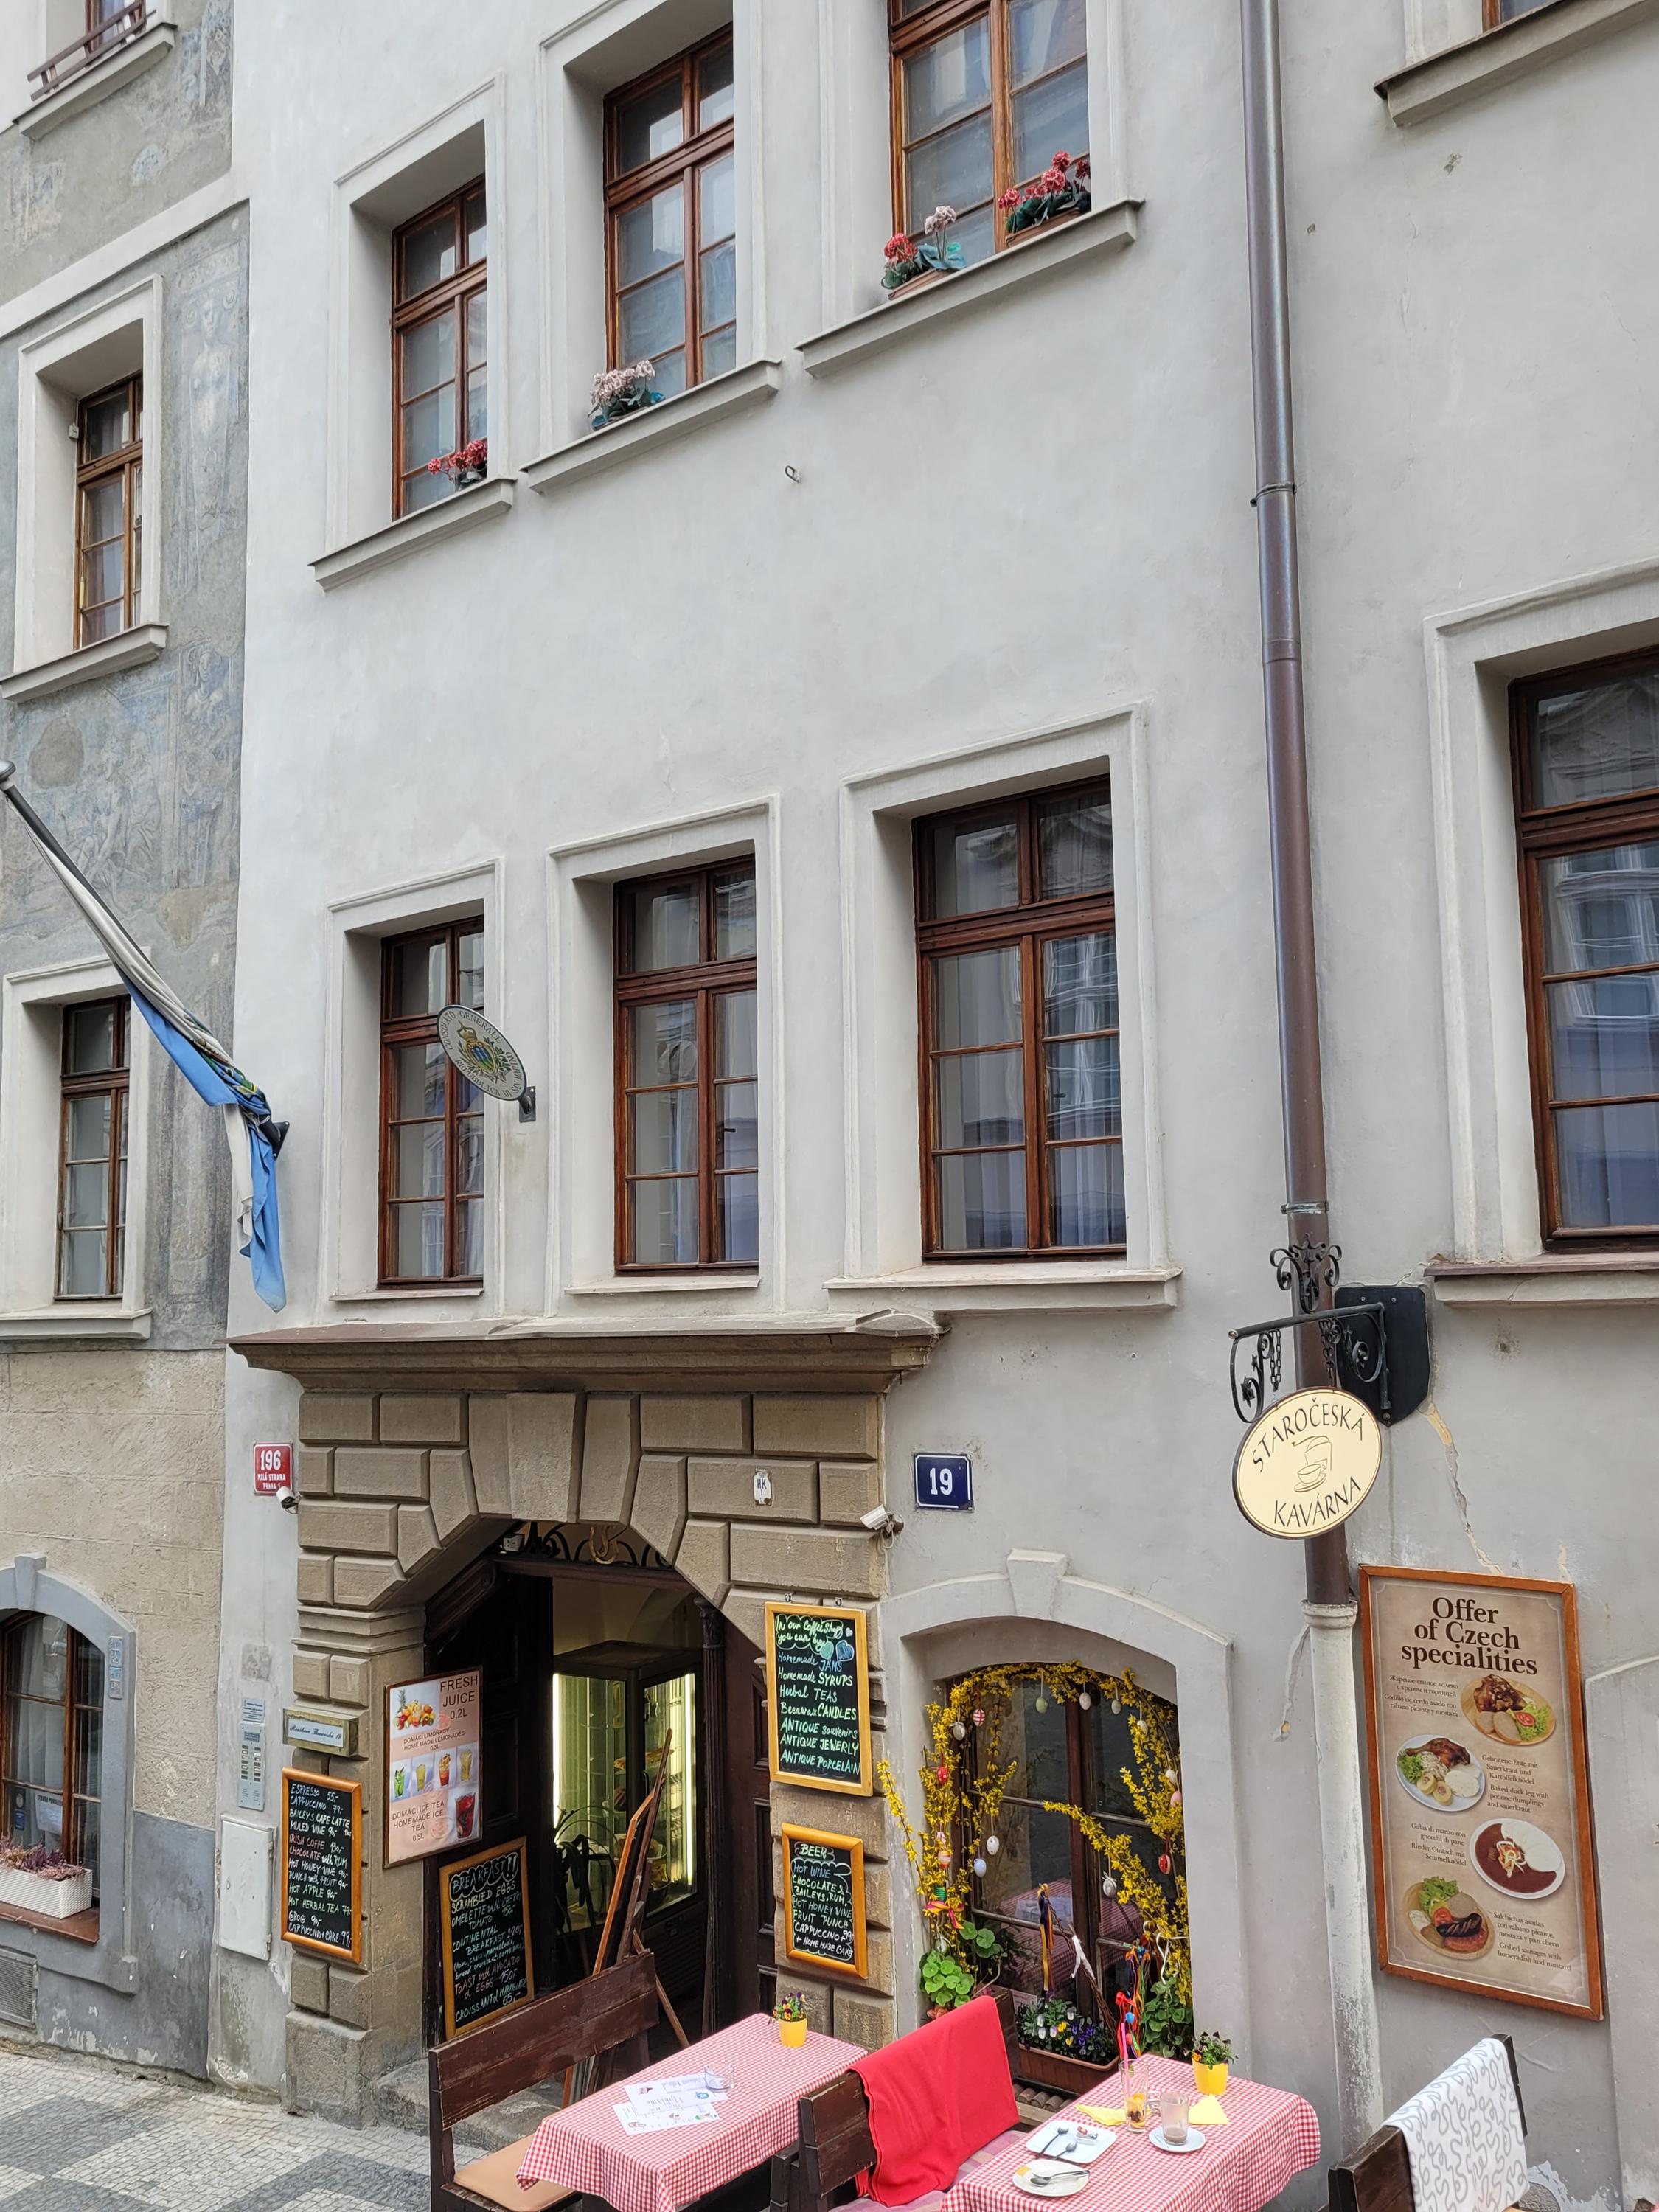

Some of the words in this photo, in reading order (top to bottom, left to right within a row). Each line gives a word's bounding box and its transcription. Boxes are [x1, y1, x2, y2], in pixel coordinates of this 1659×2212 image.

[441, 1010, 456, 1050] CONSOLATO
[459, 1010, 503, 1043] GENERALE
[1252, 1397, 1366, 1473] STAROČESKÁ
[260, 1450, 281, 1470] 196
[757, 1478, 767, 1489] HK
[930, 1468, 953, 1495] 19
[1274, 1477, 1361, 1528] KAVÁRNA
[1432, 1597, 1498, 1624] Offer
[787, 1621, 801, 1630] our
[1414, 1618, 1439, 1640] of
[1445, 1621, 1521, 1649] Czech
[777, 1632, 793, 1645] you
[794, 1632, 810, 1643] can
[778, 1651, 818, 1666] Homemade
[818, 1660, 843, 1672] JAMS
[1402, 1644, 1537, 1675] specialities
[440, 1674, 478, 1692] FRESH
[778, 1666, 816, 1683] Homemade
[818, 1672, 853, 1686] SYRUPS
[442, 1691, 475, 1708] JUICE
[779, 1684, 809, 1698] Herbal
[814, 1688, 838, 1703] TEAS
[450, 1708, 467, 1720] 0,2L
[818, 1703, 857, 1720] CANDLES
[780, 1717, 820, 1733] ANTIQUE
[404, 1742, 420, 1751] HOME
[420, 1739, 434, 1747] MADE
[434, 1730, 465, 1743] LEMONADES
[780, 1733, 818, 1748] ANTIQUE
[780, 1749, 816, 1765] ANTIQUE
[817, 1756, 861, 1775] PORCELAIN
[290, 1795, 327, 1810] CAPPUCCINO
[420, 1803, 430, 1812] ICE
[431, 1801, 445, 1809] TEA
[316, 1813, 331, 1825] CAFE
[332, 1816, 351, 1829] LATTE
[393, 1812, 431, 1829] HOMEMADE
[432, 1809, 443, 1818] ICE
[411, 1823, 425, 1832] TEA
[289, 1846, 321, 1860] CHOCOLATE
[799, 1843, 827, 1860] BEER
[793, 1863, 808, 1874] HOT
[810, 1865, 832, 1878] WINE
[302, 1884, 324, 1898] APPLE
[793, 1874, 837, 1893] CHOCOLATE
[451, 1890, 493, 1914] SCRAMBLED
[496, 1880, 516, 1897] EGGS
[302, 1899, 325, 1912] HERBAL
[327, 1903, 339, 1914] TEA
[808, 1902, 833, 1916] HONEY
[793, 1909, 817, 1924] FRUIT
[821, 1914, 849, 1930] PUNCH
[795, 1921, 839, 1941] CAPPUCCINO
[803, 1937, 819, 1948] HOME
[820, 1941, 835, 1952] MADE
